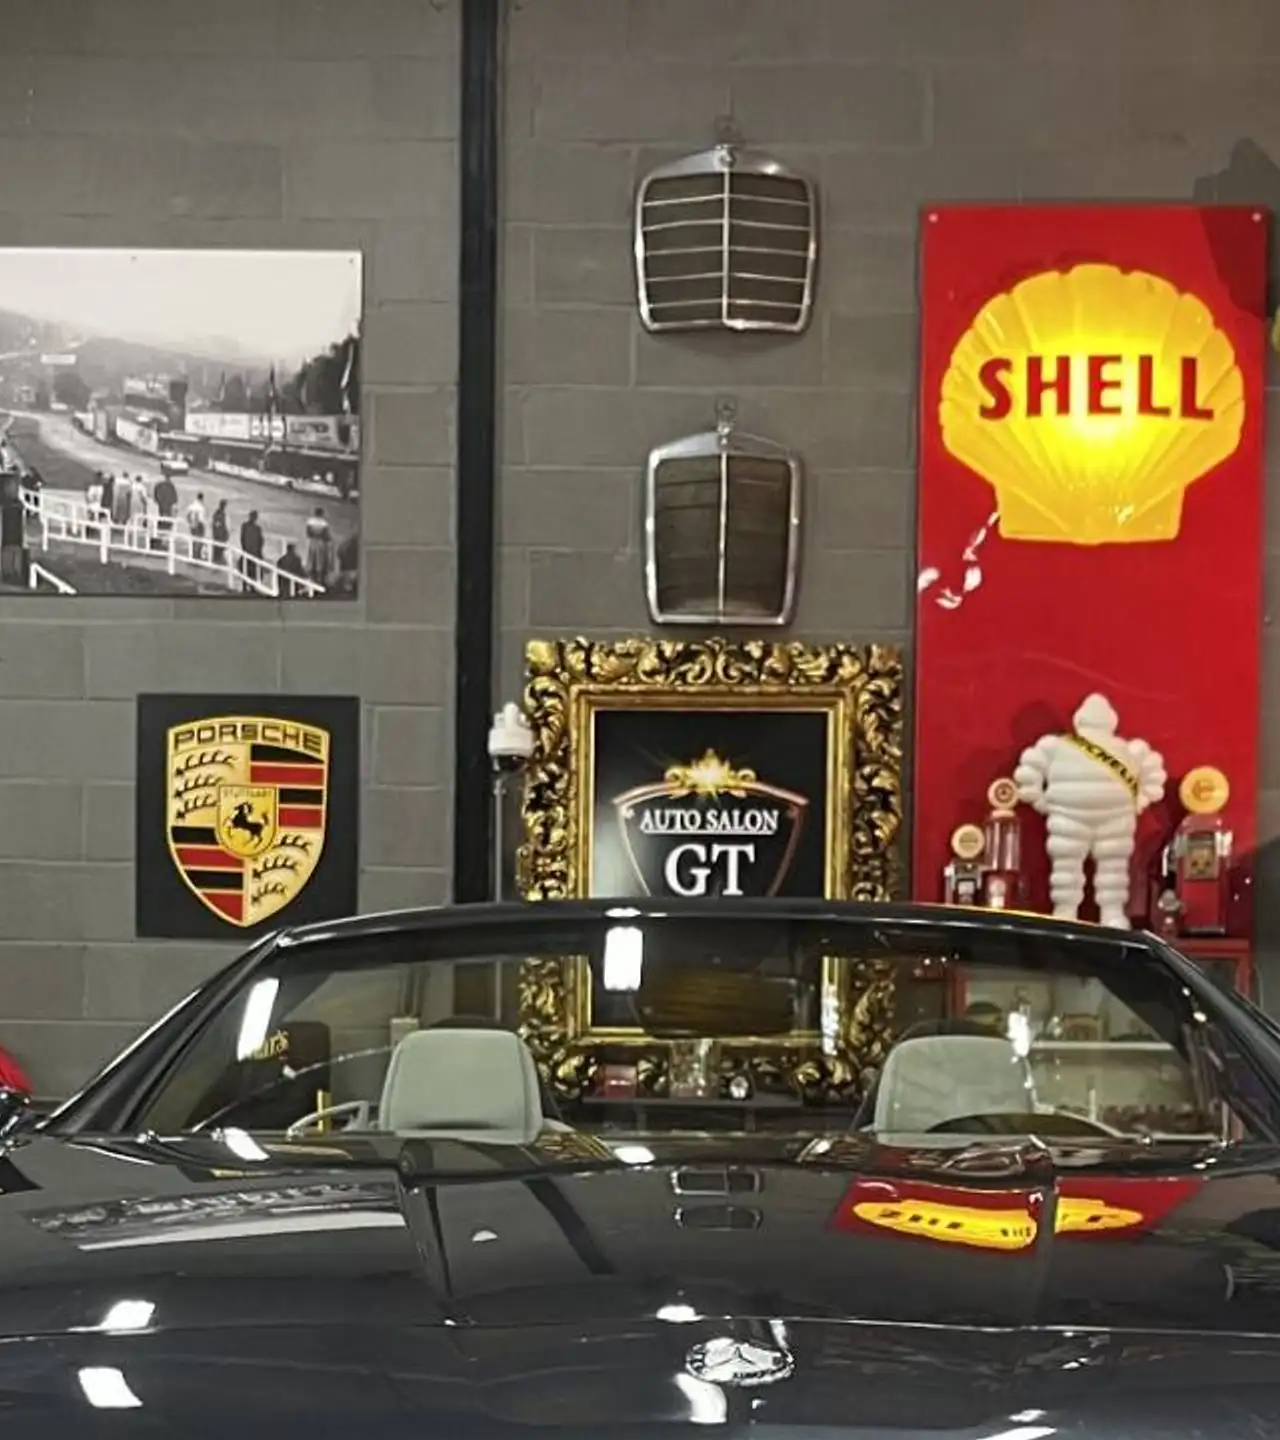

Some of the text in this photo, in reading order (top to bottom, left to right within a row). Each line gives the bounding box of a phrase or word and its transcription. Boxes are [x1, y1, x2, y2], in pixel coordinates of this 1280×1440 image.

[978, 355, 1214, 421] SHELL
[174, 723, 322, 754] PORSCHE
[640, 808, 780, 832] AUTO SALON
[664, 843, 756, 897] GT
